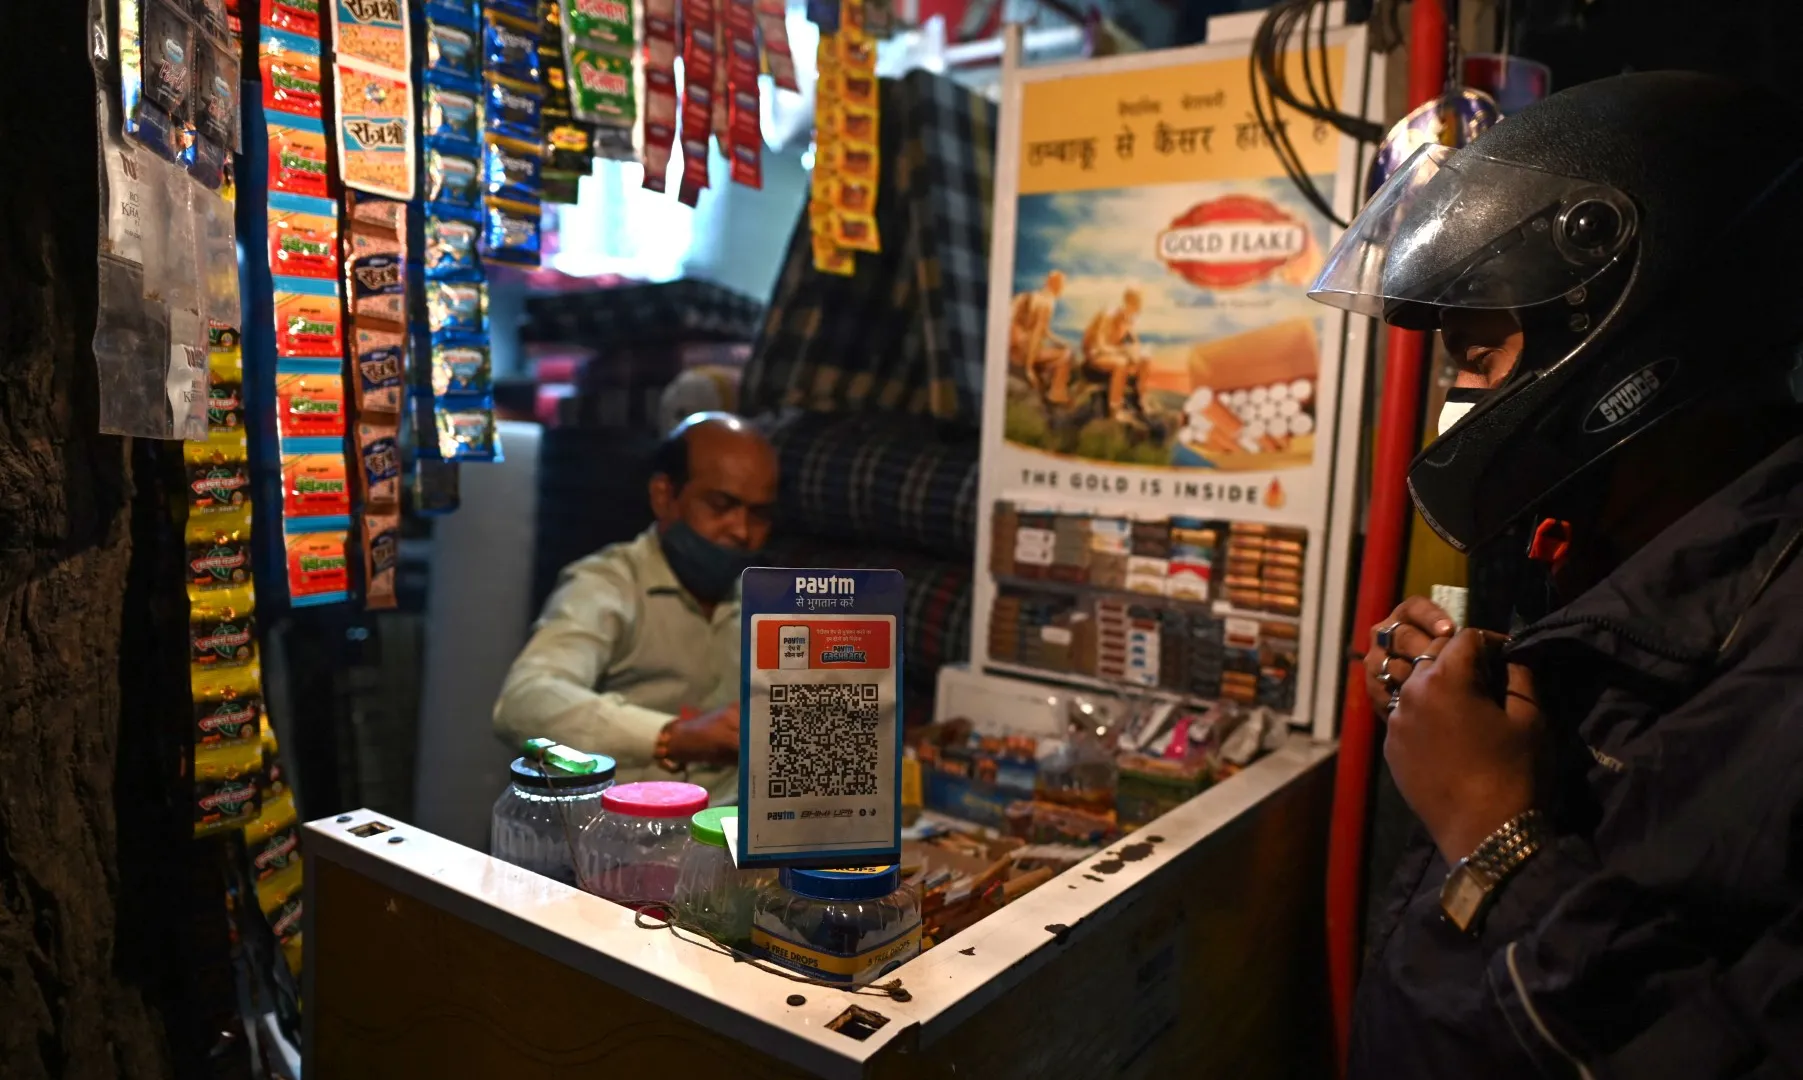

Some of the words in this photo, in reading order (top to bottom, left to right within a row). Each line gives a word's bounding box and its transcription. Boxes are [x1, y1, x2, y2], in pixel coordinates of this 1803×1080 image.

[1116, 126, 1134, 158] से
[1165, 232, 1221, 254] GOLD
[1231, 230, 1294, 252] FLAKE
[1599, 369, 1659, 422] STUDDS
[1021, 469, 1058, 487] THE
[1069, 472, 1129, 494] GOLD
[1140, 478, 1162, 497] IS
[1174, 481, 1259, 505] INSIDE
[796, 595, 804, 607] से
[807, 598, 837, 610] भुगतान
[840, 596, 855, 607] करें
[771, 945, 790, 959] FREE
[790, 951, 819, 968] DROPS
